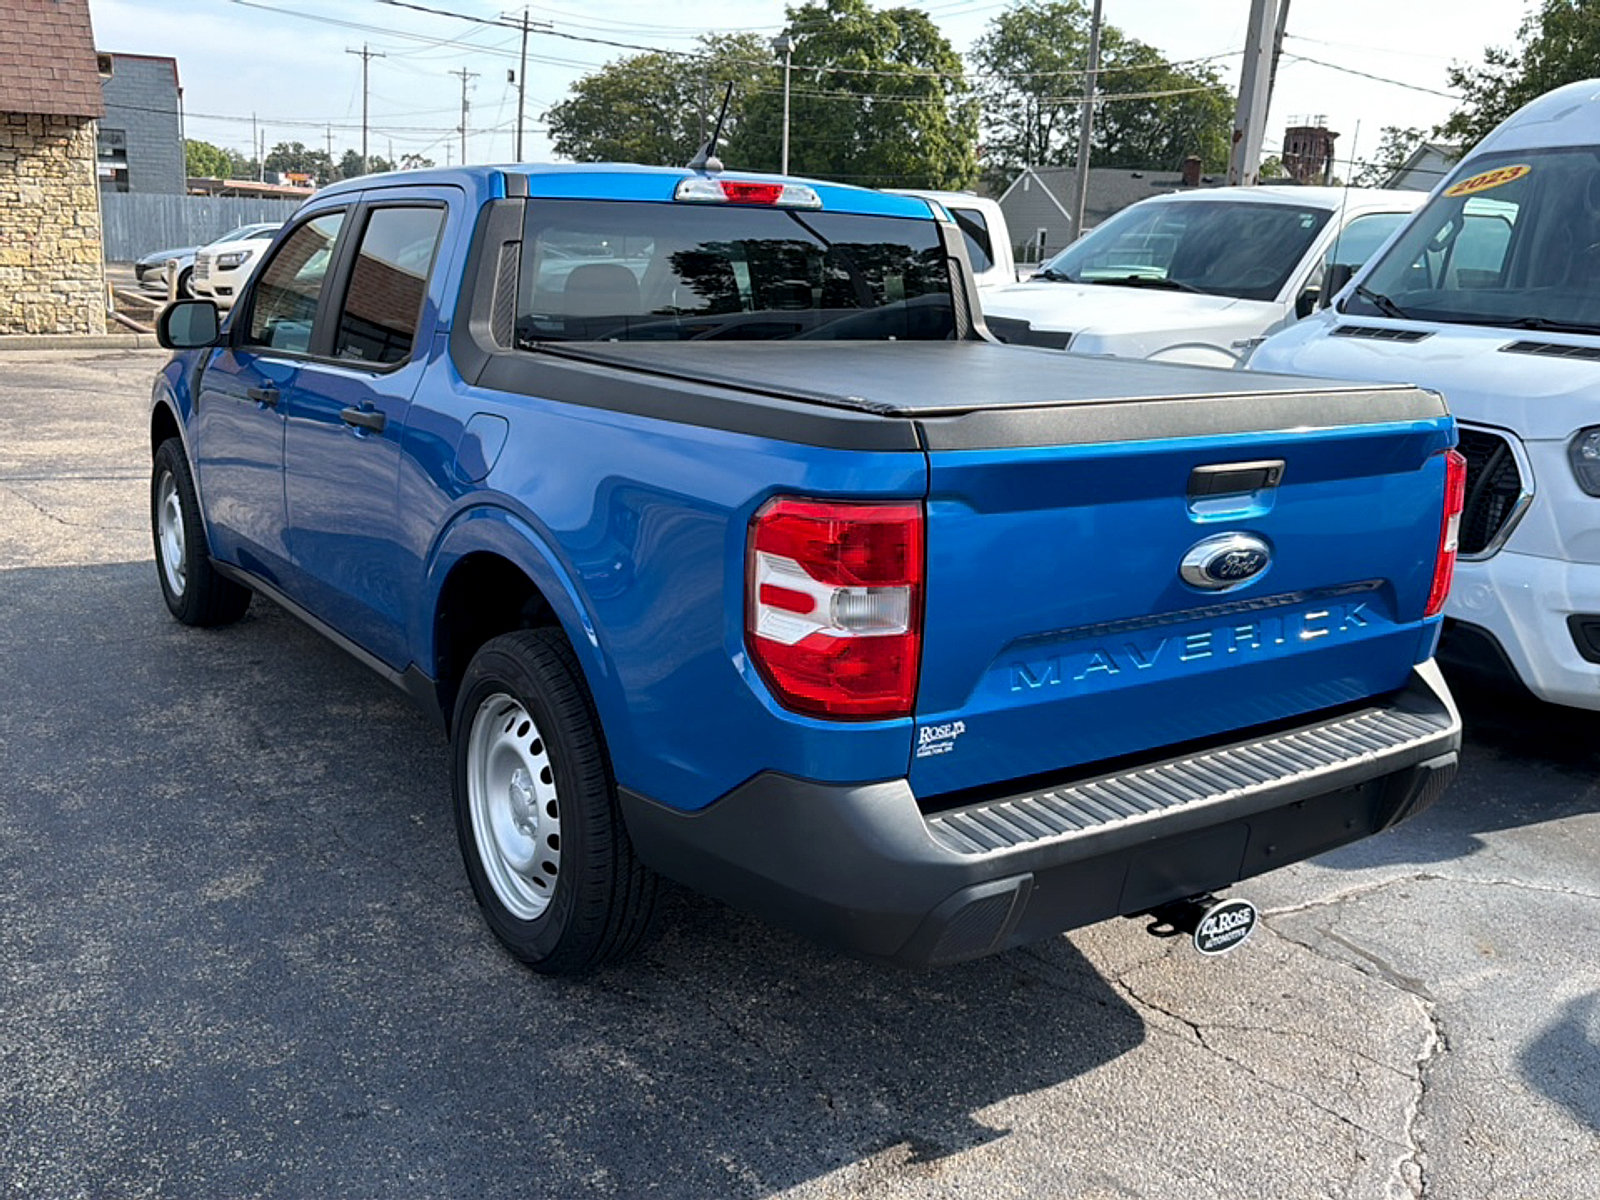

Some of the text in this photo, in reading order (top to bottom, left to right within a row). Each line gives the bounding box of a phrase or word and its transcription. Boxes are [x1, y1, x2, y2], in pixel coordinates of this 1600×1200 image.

[1448, 166, 1523, 195] 2023
[1220, 551, 1260, 575] Ford
[1010, 602, 1367, 691] MAVERICK
[1218, 907, 1252, 932] ROSE
